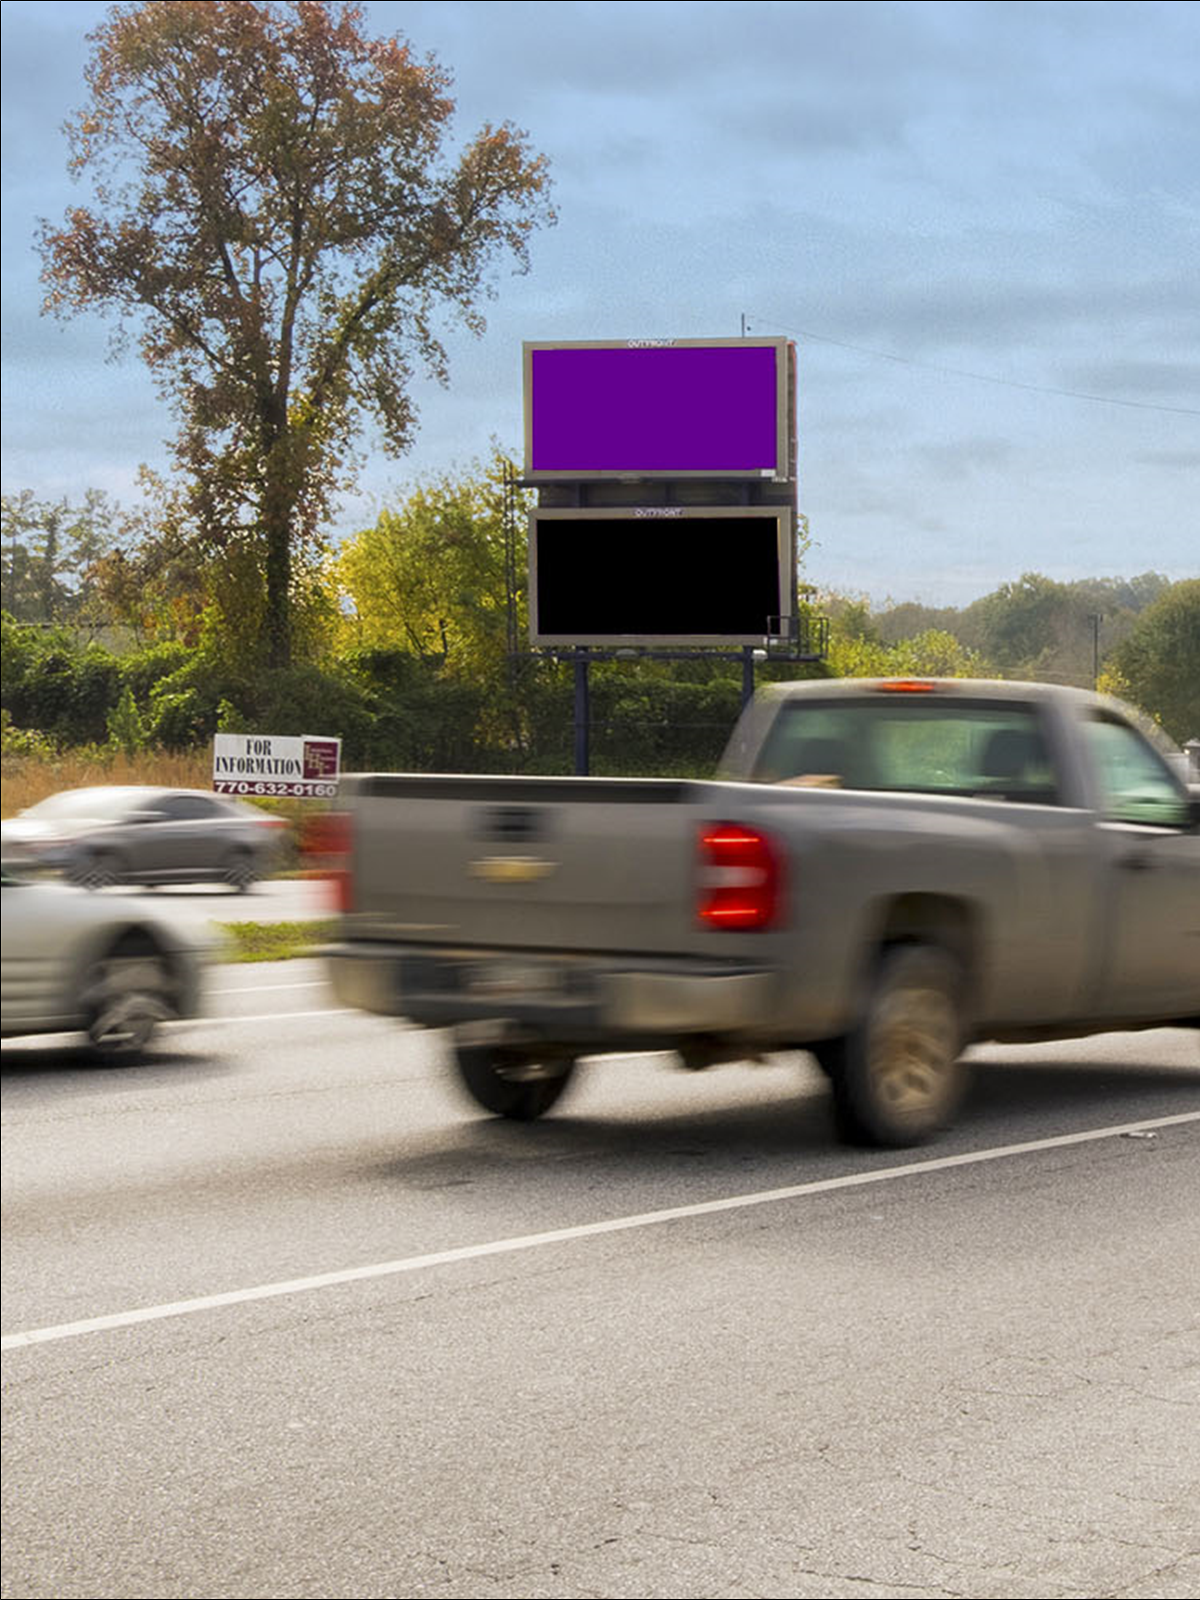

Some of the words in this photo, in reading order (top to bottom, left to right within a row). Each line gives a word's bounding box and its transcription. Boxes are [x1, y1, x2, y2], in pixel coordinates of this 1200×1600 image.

[247, 739, 271, 755] FOR
[216, 756, 302, 774] INFORMATION
[216, 782, 336, 797] 770-632-0160
